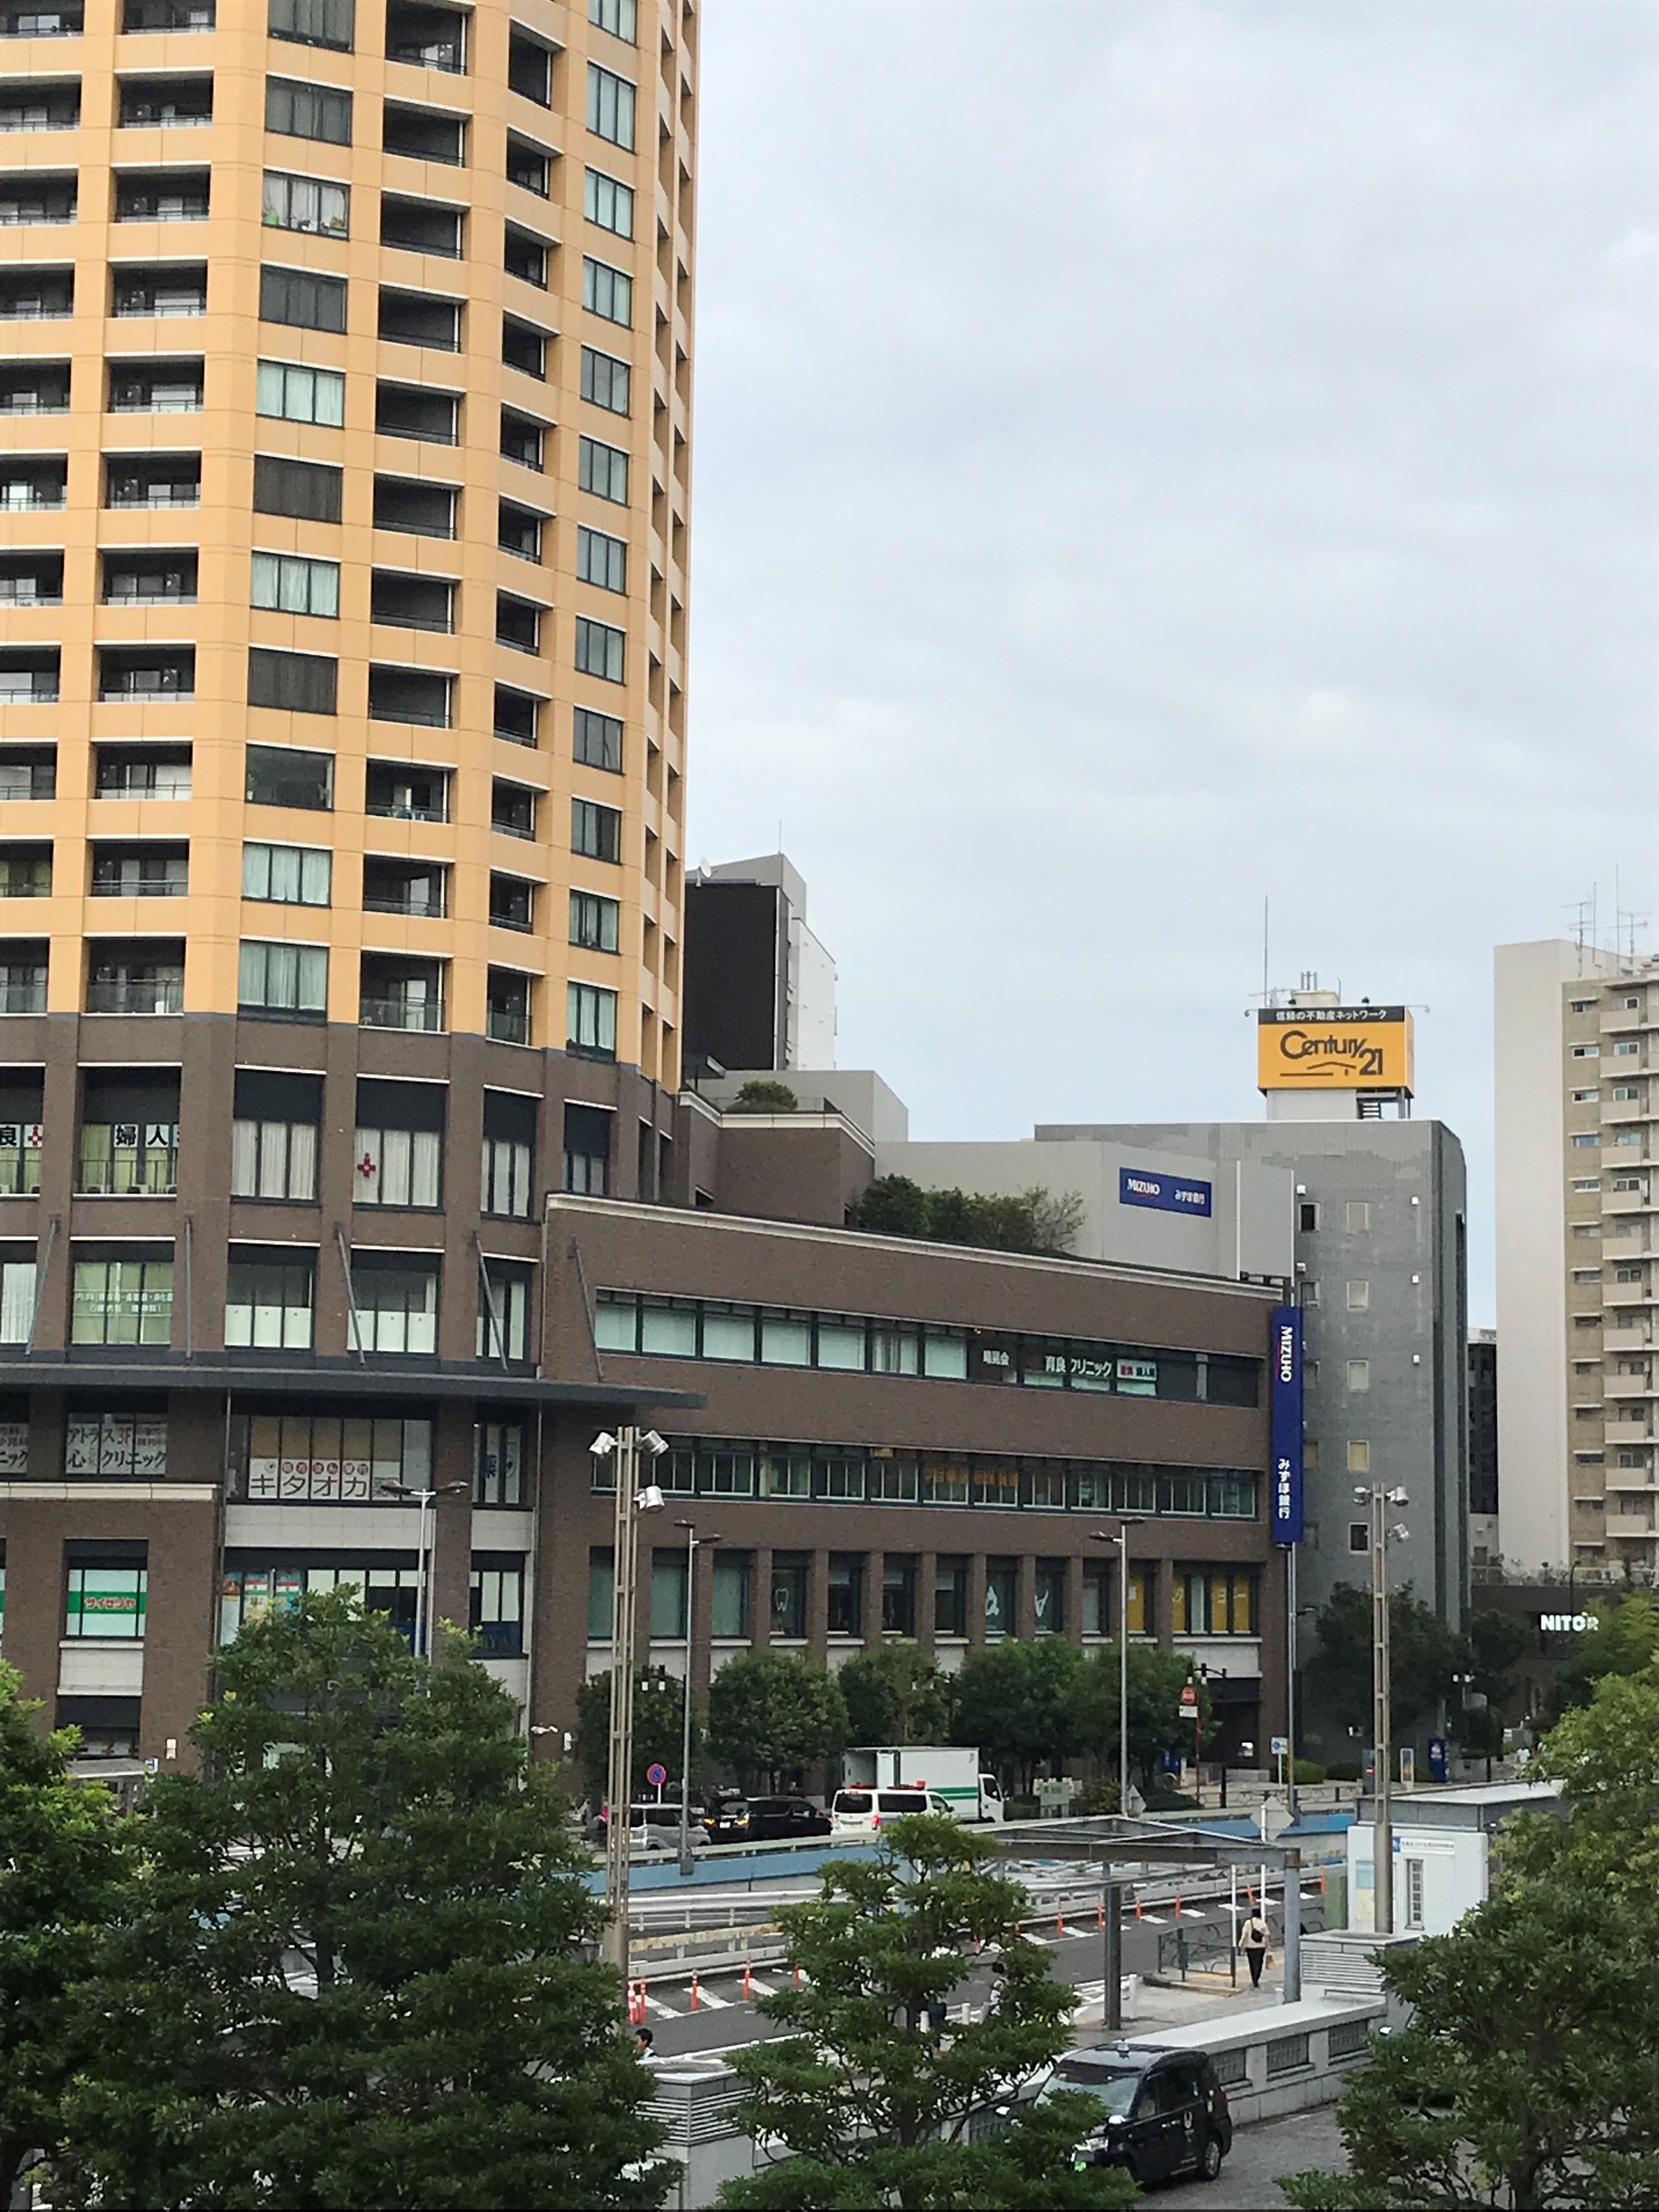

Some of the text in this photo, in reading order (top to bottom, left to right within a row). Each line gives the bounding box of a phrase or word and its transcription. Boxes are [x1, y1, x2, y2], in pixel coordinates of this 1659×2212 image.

[1280, 1030, 1384, 1075] Century 21
[116, 1125, 179, 1146] 婦人
[1127, 1178, 1160, 1195] MIZUHO
[1280, 1325, 1293, 1382] MIZUHO
